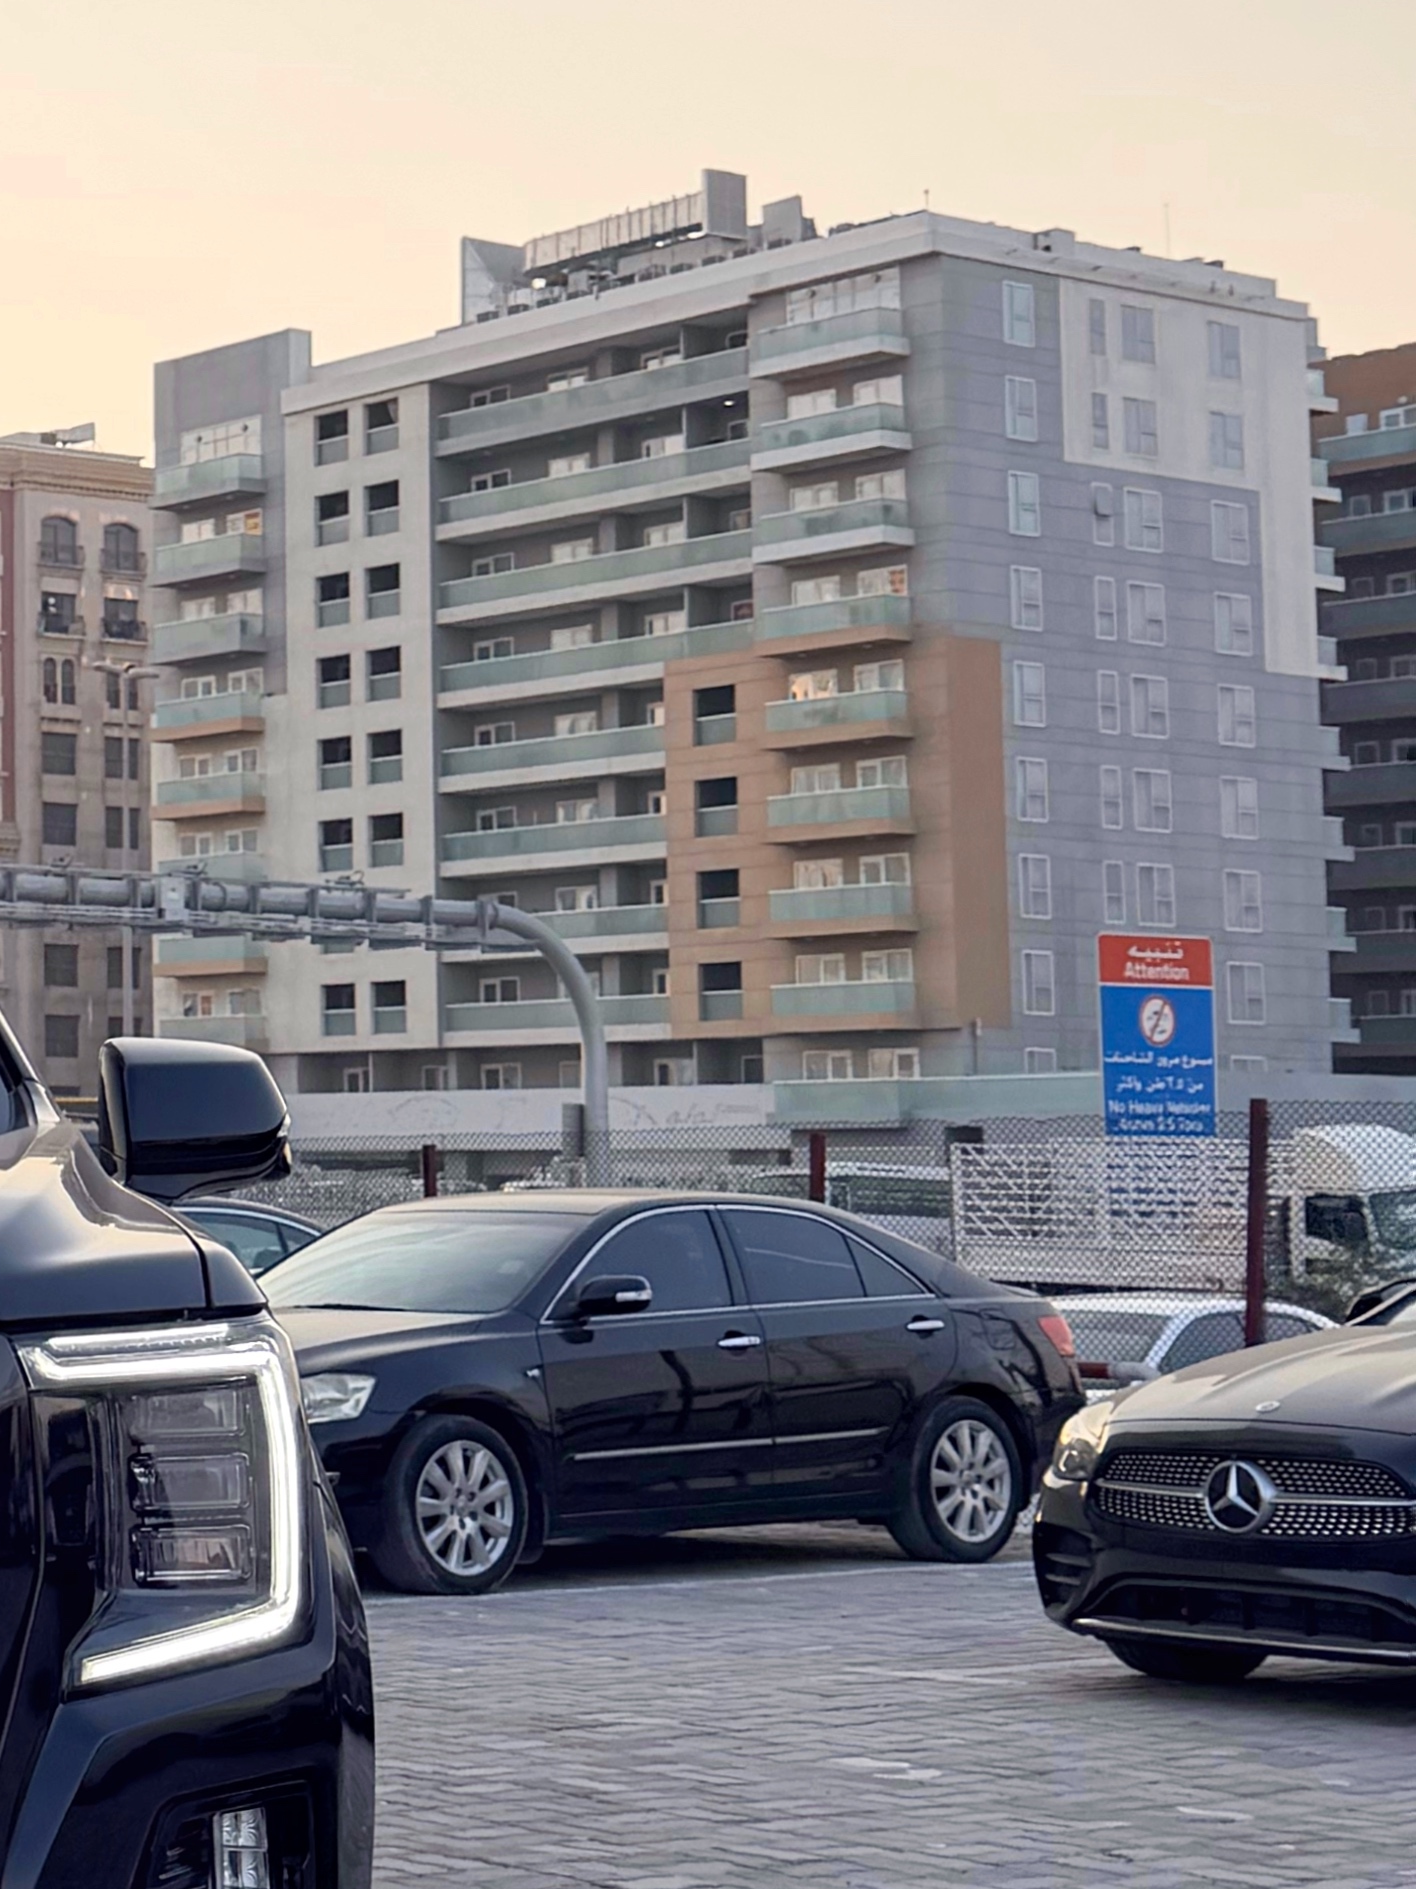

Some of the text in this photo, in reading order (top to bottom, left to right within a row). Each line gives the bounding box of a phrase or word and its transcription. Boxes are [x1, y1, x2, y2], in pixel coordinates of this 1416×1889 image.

[1127, 940, 1184, 963] تنبيه
[1124, 961, 1190, 981] Attention
[1108, 1100, 1126, 1113] No
